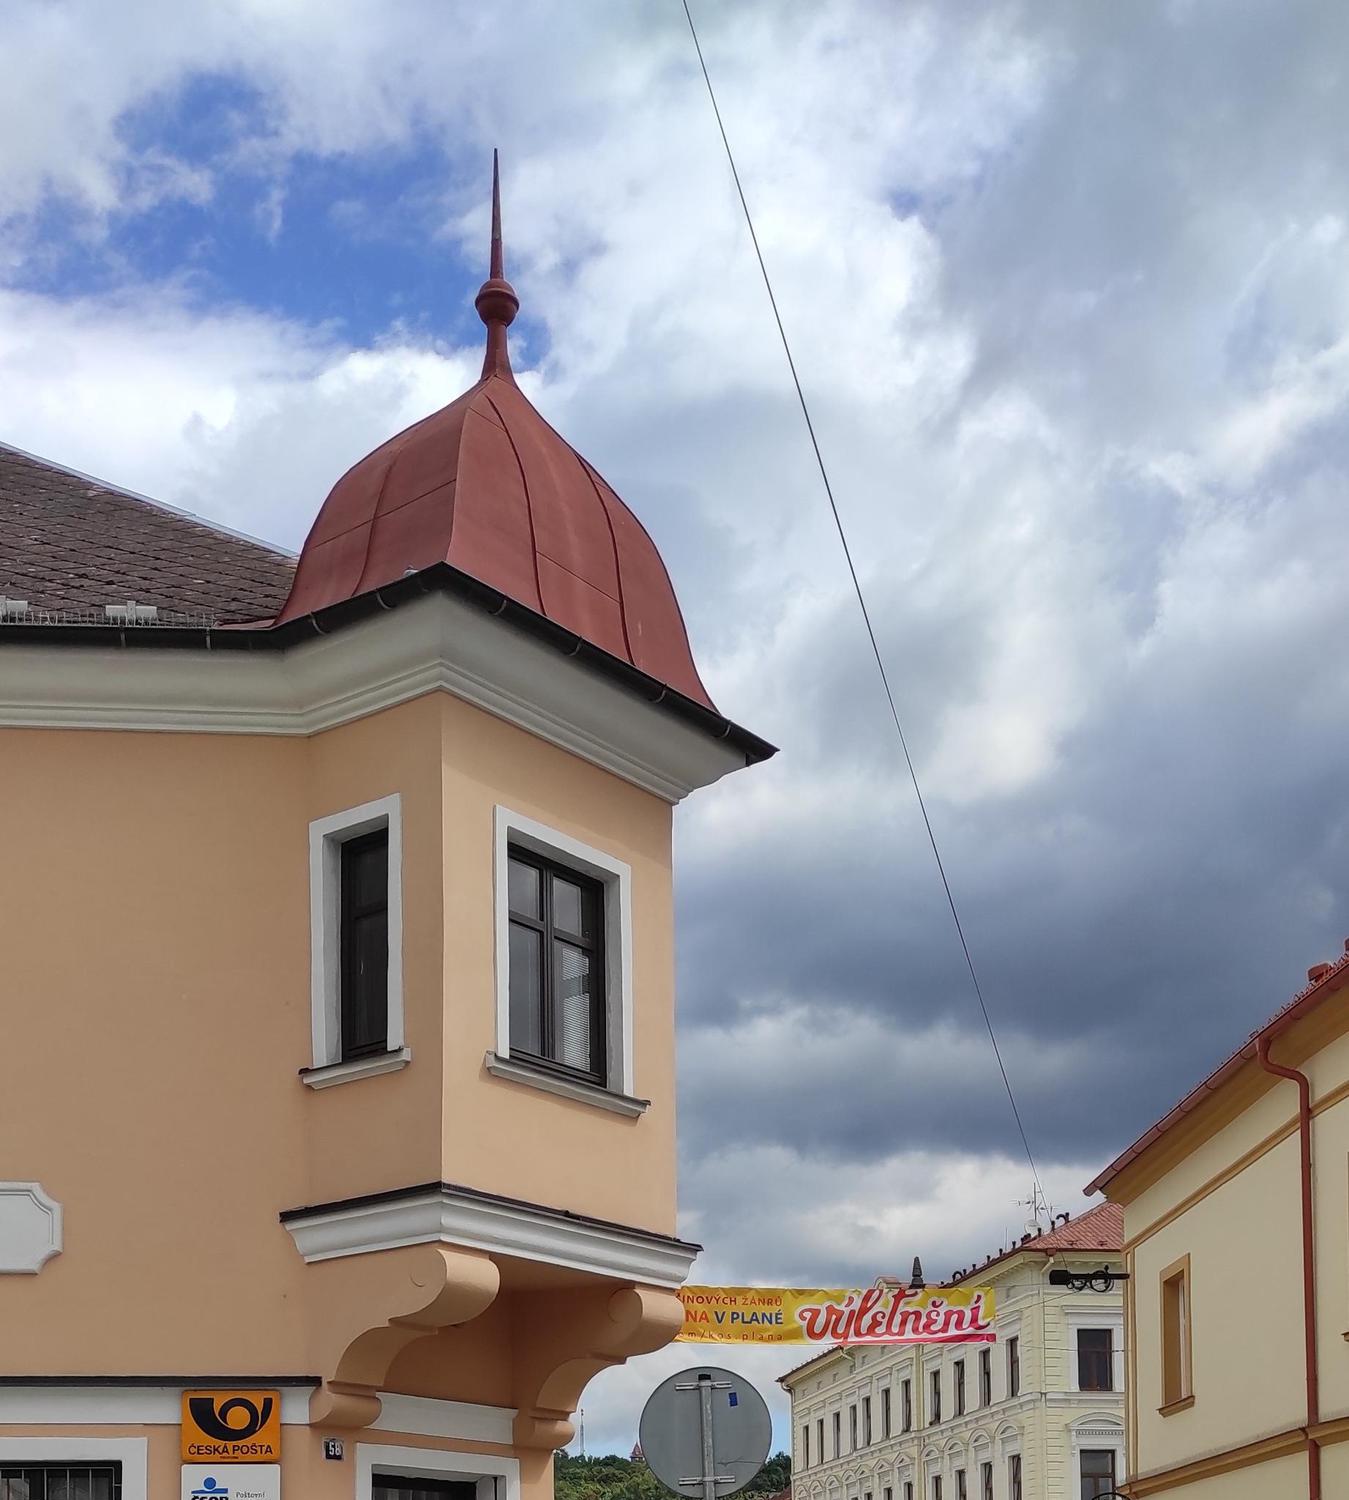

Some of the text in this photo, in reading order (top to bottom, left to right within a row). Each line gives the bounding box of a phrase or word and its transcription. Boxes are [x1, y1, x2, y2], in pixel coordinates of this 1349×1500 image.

[677, 1292, 783, 1307] INOVÝCH ŽÁNRŮ
[714, 1311, 726, 1324] V
[730, 1309, 784, 1325] PLANÉ
[188, 1443, 273, 1456] ČESKÁ POŠTA
[329, 1441, 341, 1456] 58
[235, 1491, 265, 1499] Poštovní
